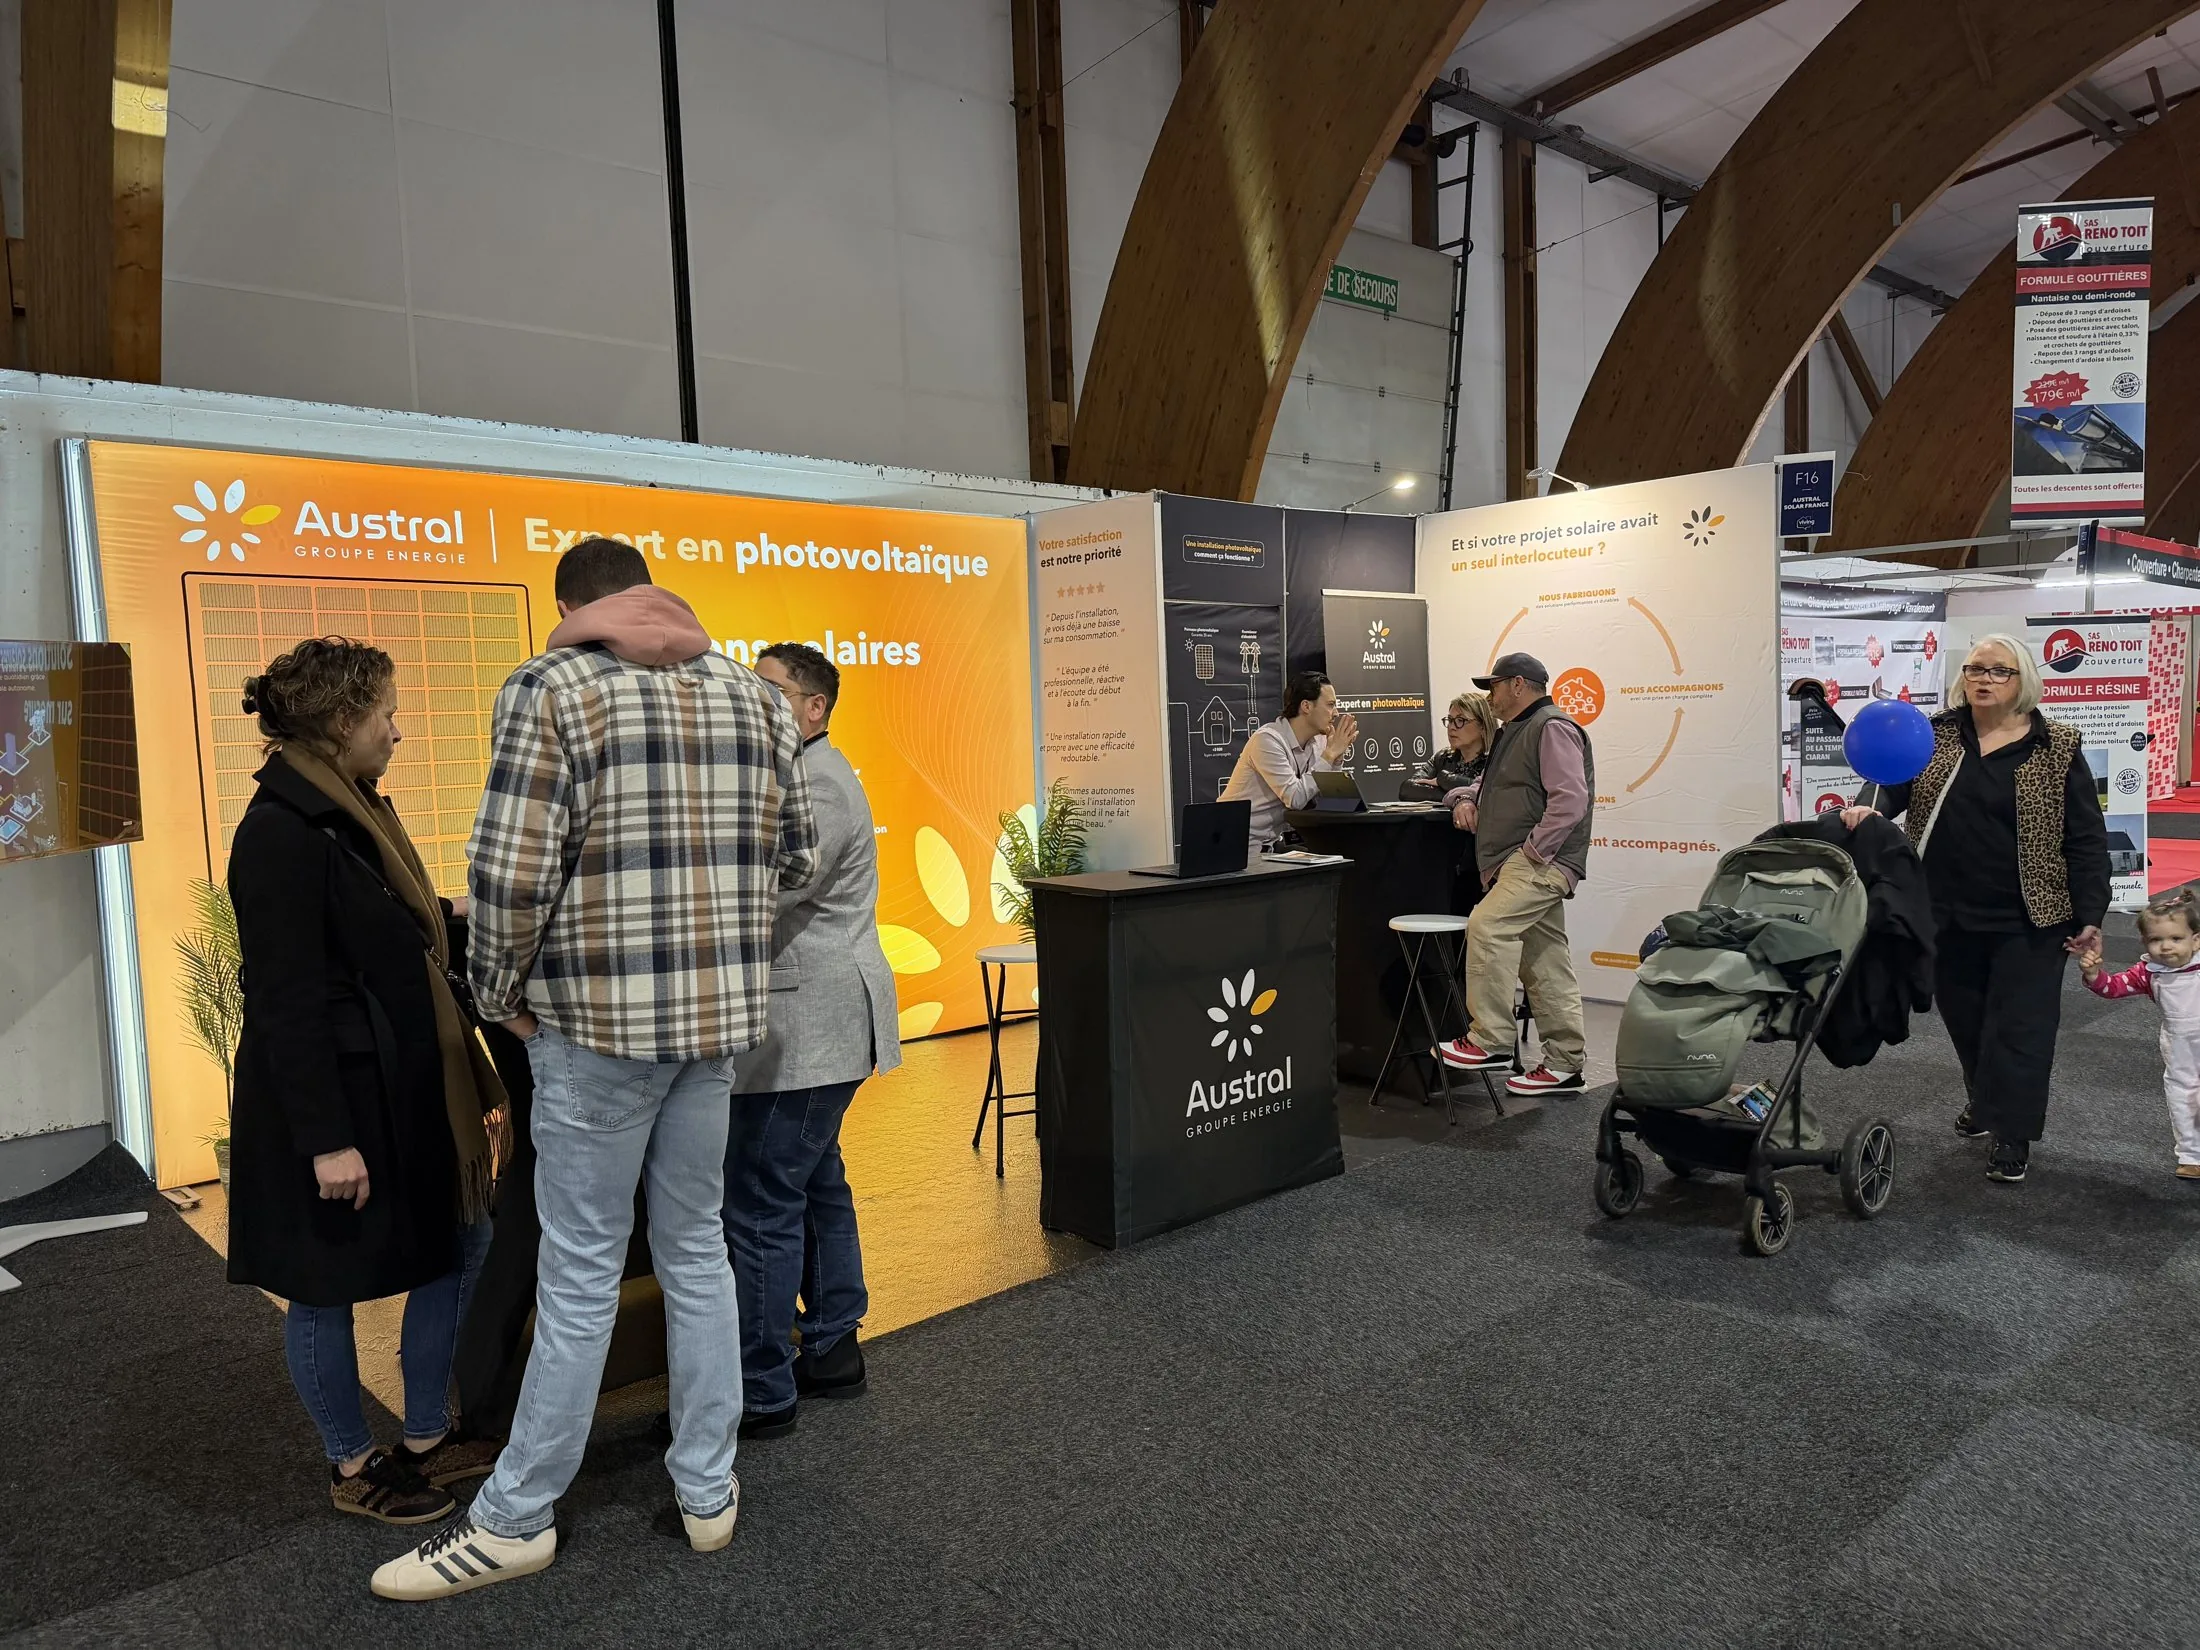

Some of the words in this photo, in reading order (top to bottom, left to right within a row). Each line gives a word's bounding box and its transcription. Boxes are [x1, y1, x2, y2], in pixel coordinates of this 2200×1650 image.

[2084, 219, 2099, 227] SAS
[2084, 227, 2118, 239] RENO
[2121, 226, 2148, 237] TOIT
[2087, 243, 2148, 253] ouverture
[2020, 274, 2074, 286] FORMULE
[2077, 270, 2147, 283] GOUTTIÈRES
[1337, 272, 1351, 295] DE
[1354, 275, 1397, 306] SECOURS
[2031, 294, 2070, 303] Nantaise
[2085, 290, 2136, 300] demi-ronde
[2033, 389, 2064, 403] 179€
[2067, 388, 2080, 398] m/l
[1795, 471, 1819, 485] F16
[2053, 484, 2092, 492] descentes
[294, 501, 463, 544] Austral
[1452, 539, 1465, 551] Et
[1467, 536, 1478, 549] si
[1481, 533, 1516, 547] votre
[1520, 526, 1563, 546] projet
[1566, 521, 1616, 537] solaire
[1620, 512, 1659, 530] avait
[1039, 540, 1064, 551] Votre
[1066, 530, 1122, 547] satisfaction
[295, 546, 374, 560] GROUPE
[387, 551, 465, 564] ENERGIE
[525, 517, 666, 559] Exrt
[677, 537, 723, 562] en
[735, 533, 988, 583] photovoltaïque
[1041, 557, 1054, 568] est
[1056, 553, 1081, 565] notre
[1084, 546, 1122, 565] priorité
[1451, 560, 1468, 572] un
[1471, 554, 1498, 570] seul
[1501, 545, 1593, 567] interlocuteur
[1598, 541, 1606, 555] ?
[1224, 553, 1251, 562] fonctionne
[2132, 553, 2167, 577] Couverture
[1538, 593, 1561, 602] NOUS
[1563, 588, 1616, 600] FABRIQUONS
[1051, 612, 1074, 622] Depuis
[1075, 608, 1119, 619] l'installation,
[1045, 625, 1051, 635] je
[1052, 624, 1065, 632] vois
[1066, 621, 1081, 632] déjà
[1083, 622, 1096, 630] une
[1098, 618, 1120, 628] baisse
[1043, 637, 1053, 645] sur
[1065, 630, 1119, 642] consommation.
[2088, 632, 2100, 640] SAS
[769, 630, 921, 666] laires
[1782, 638, 1797, 649] RENO
[1798, 638, 1810, 649] TOIT
[2089, 641, 2118, 652] RENO
[2120, 640, 2142, 651] TOIT
[1363, 651, 1395, 663] Austral
[2084, 657, 2144, 665] couverture
[1061, 666, 1090, 676] L'équipe
[1097, 664, 1110, 673] été
[1044, 677, 1095, 689] professionnelle,
[1096, 675, 1125, 684] réactive
[1620, 686, 1645, 694] NOUS
[1646, 683, 1724, 693] ACCOMPAGNONS
[1060, 689, 1086, 697] l'écoute
[1087, 687, 1097, 695] du
[1099, 686, 1121, 695] début
[2043, 685, 2093, 697] ORMULE
[2096, 682, 2140, 695] RÉSINE
[1073, 699, 1079, 707] la
[1080, 698, 1091, 707] fin.
[1335, 699, 1361, 711] Expert
[1361, 700, 1371, 709] en
[1372, 697, 1425, 711] photovoltaïque
[1050, 733, 1062, 741] Une
[1064, 731, 1100, 740] installation
[1102, 730, 1126, 740] rapide
[1046, 746, 1066, 754] propre
[1100, 741, 1135, 750] efficacité
[1060, 754, 1100, 762] redoutable.
[1087, 798, 1135, 806] l'installation
[1098, 808, 1103, 816] il
[1116, 808, 1129, 817] fait
[1085, 820, 1106, 828] beau.
[1611, 839, 1721, 854] accompagnés.
[1185, 1056, 1292, 1118] Austral
[1186, 1115, 1236, 1138] GROUPE
[1243, 1098, 1292, 1122] ENERGIE
